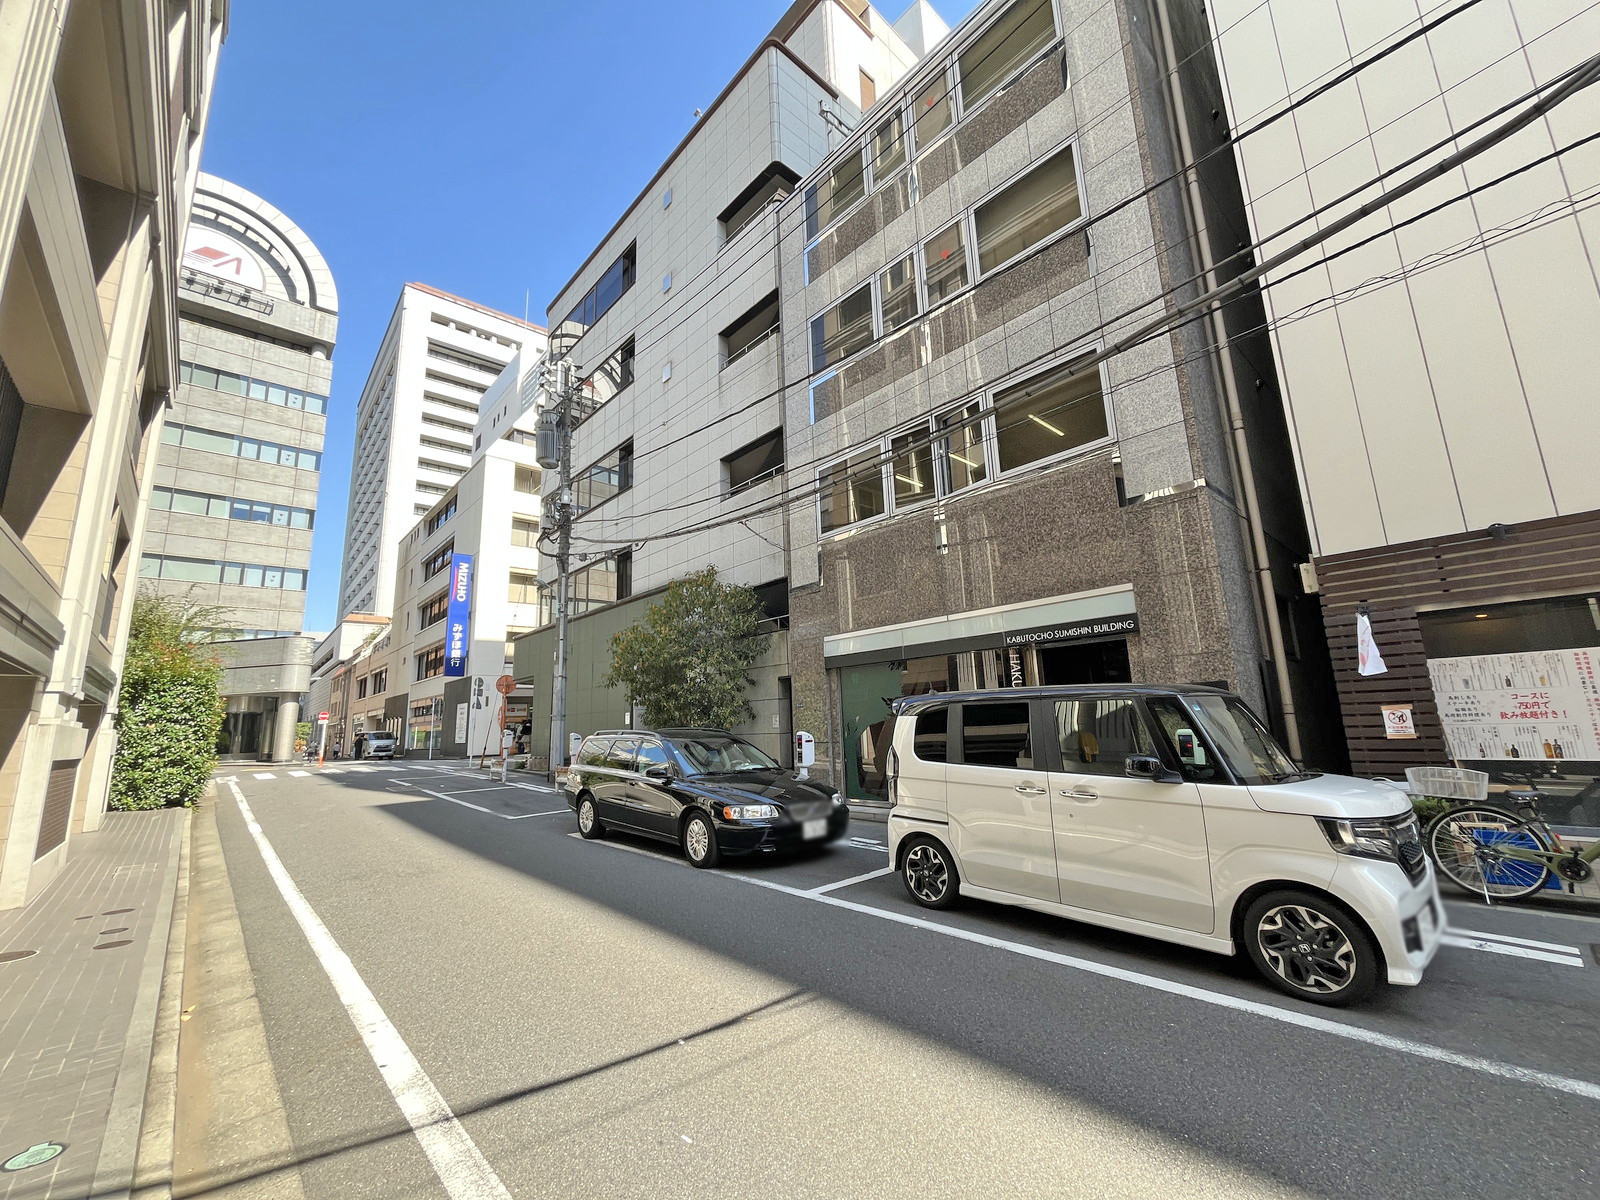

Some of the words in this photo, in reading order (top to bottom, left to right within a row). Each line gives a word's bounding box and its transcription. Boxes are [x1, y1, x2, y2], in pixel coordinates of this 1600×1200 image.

[457, 562, 469, 602] MIZUHO
[450, 623, 463, 667] みずほ銀行
[1006, 631, 1054, 644] KABUTOCHO
[1054, 626, 1092, 638] SUMISHIN
[1093, 620, 1135, 634] BUILDING
[1511, 692, 1550, 700] コースに
